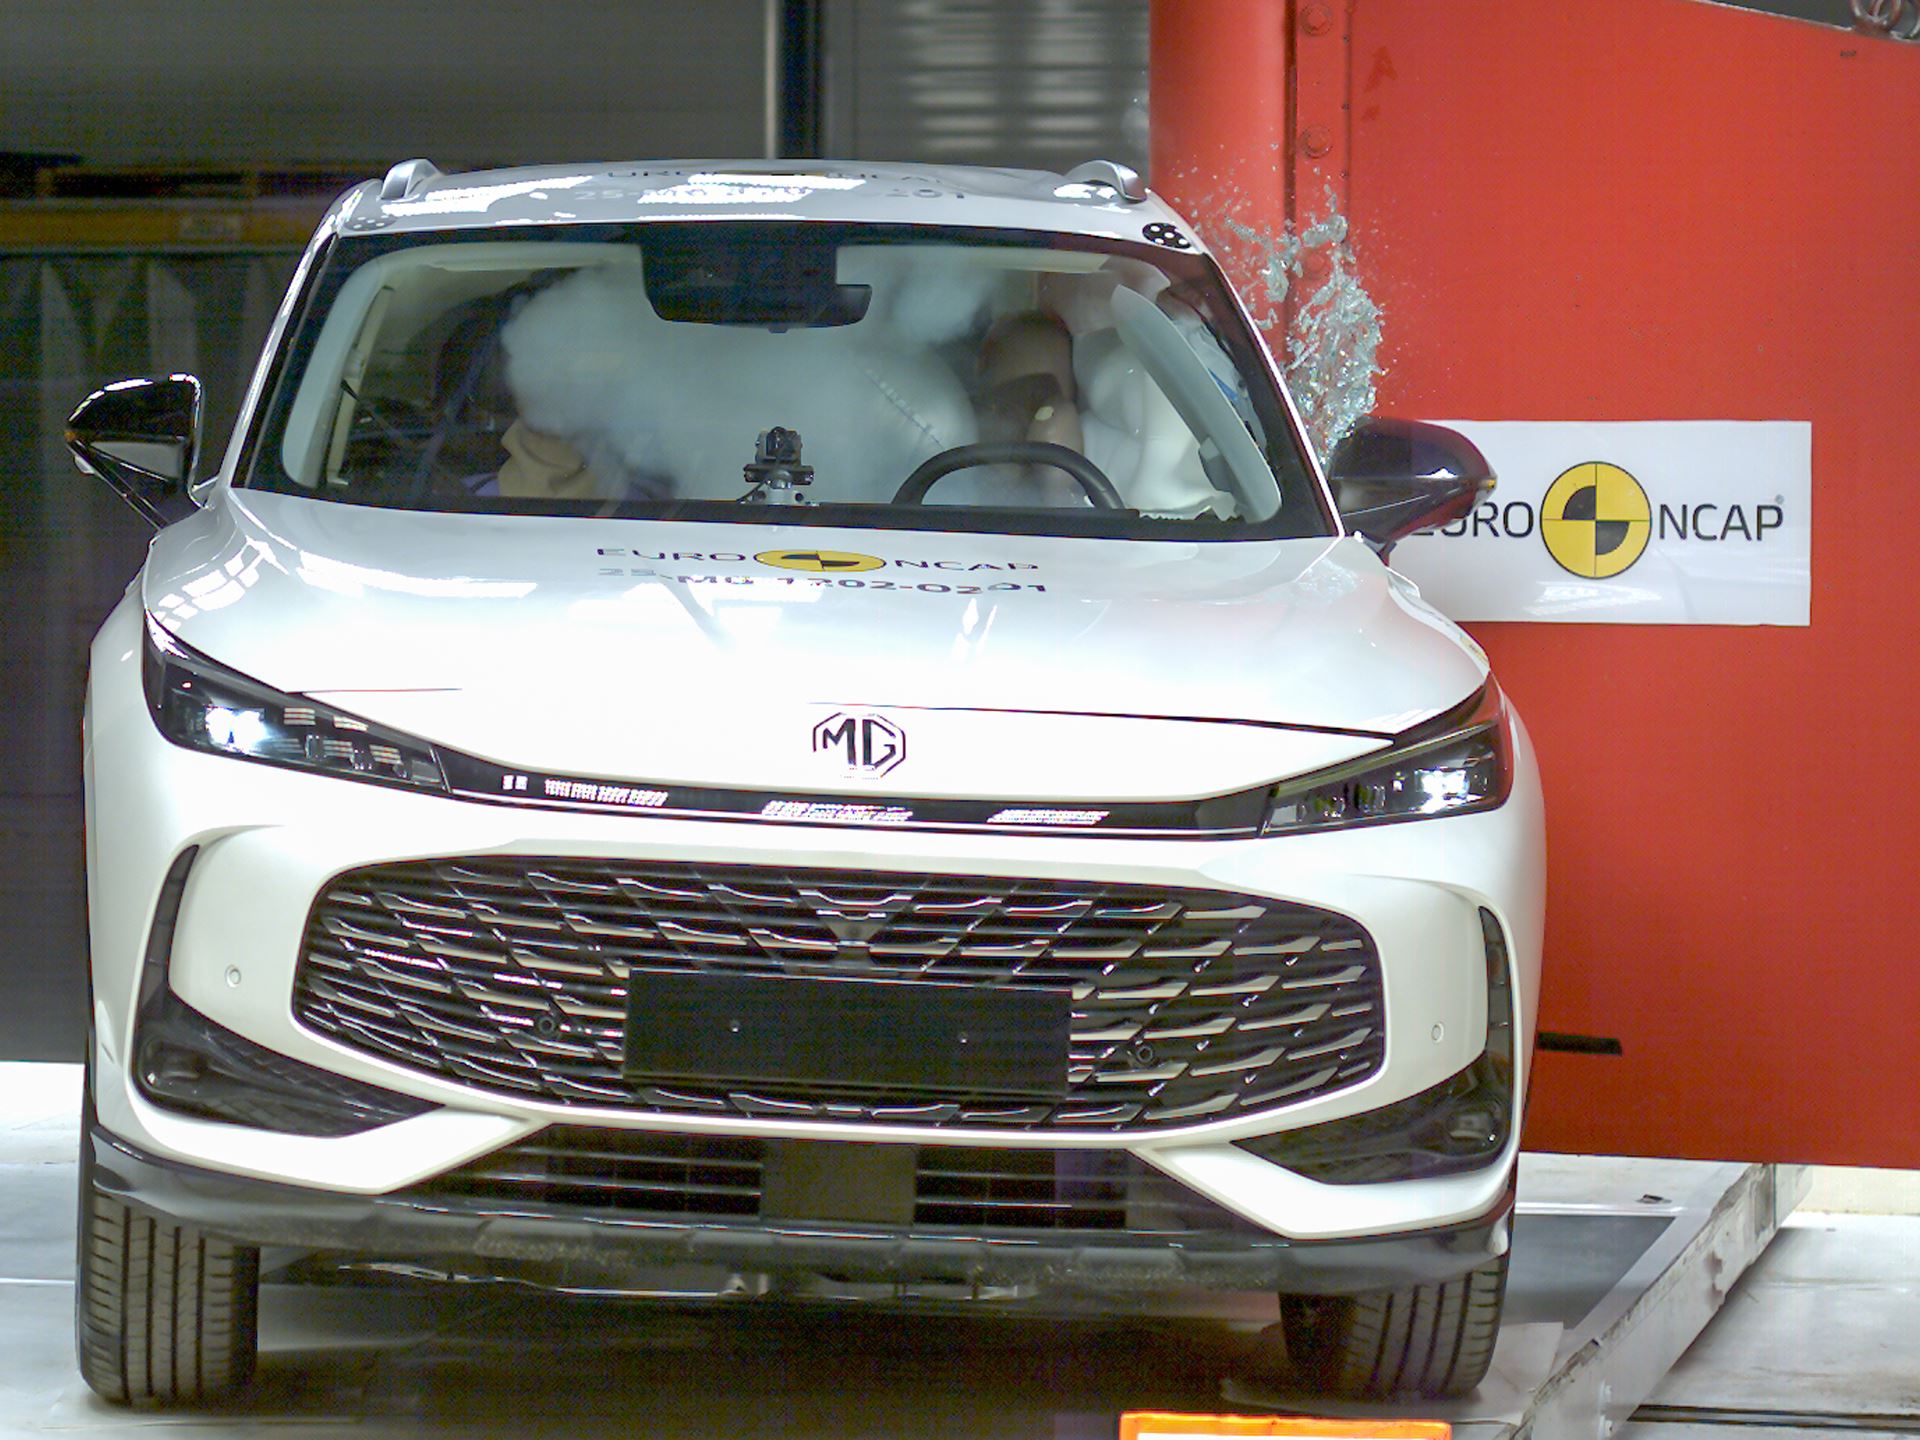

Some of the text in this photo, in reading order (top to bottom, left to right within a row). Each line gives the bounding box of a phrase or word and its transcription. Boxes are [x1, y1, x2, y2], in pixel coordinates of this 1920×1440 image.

[1659, 503, 1784, 542] NCAP
[597, 548, 1039, 571] EURO NCAP
[822, 718, 897, 771] MG
